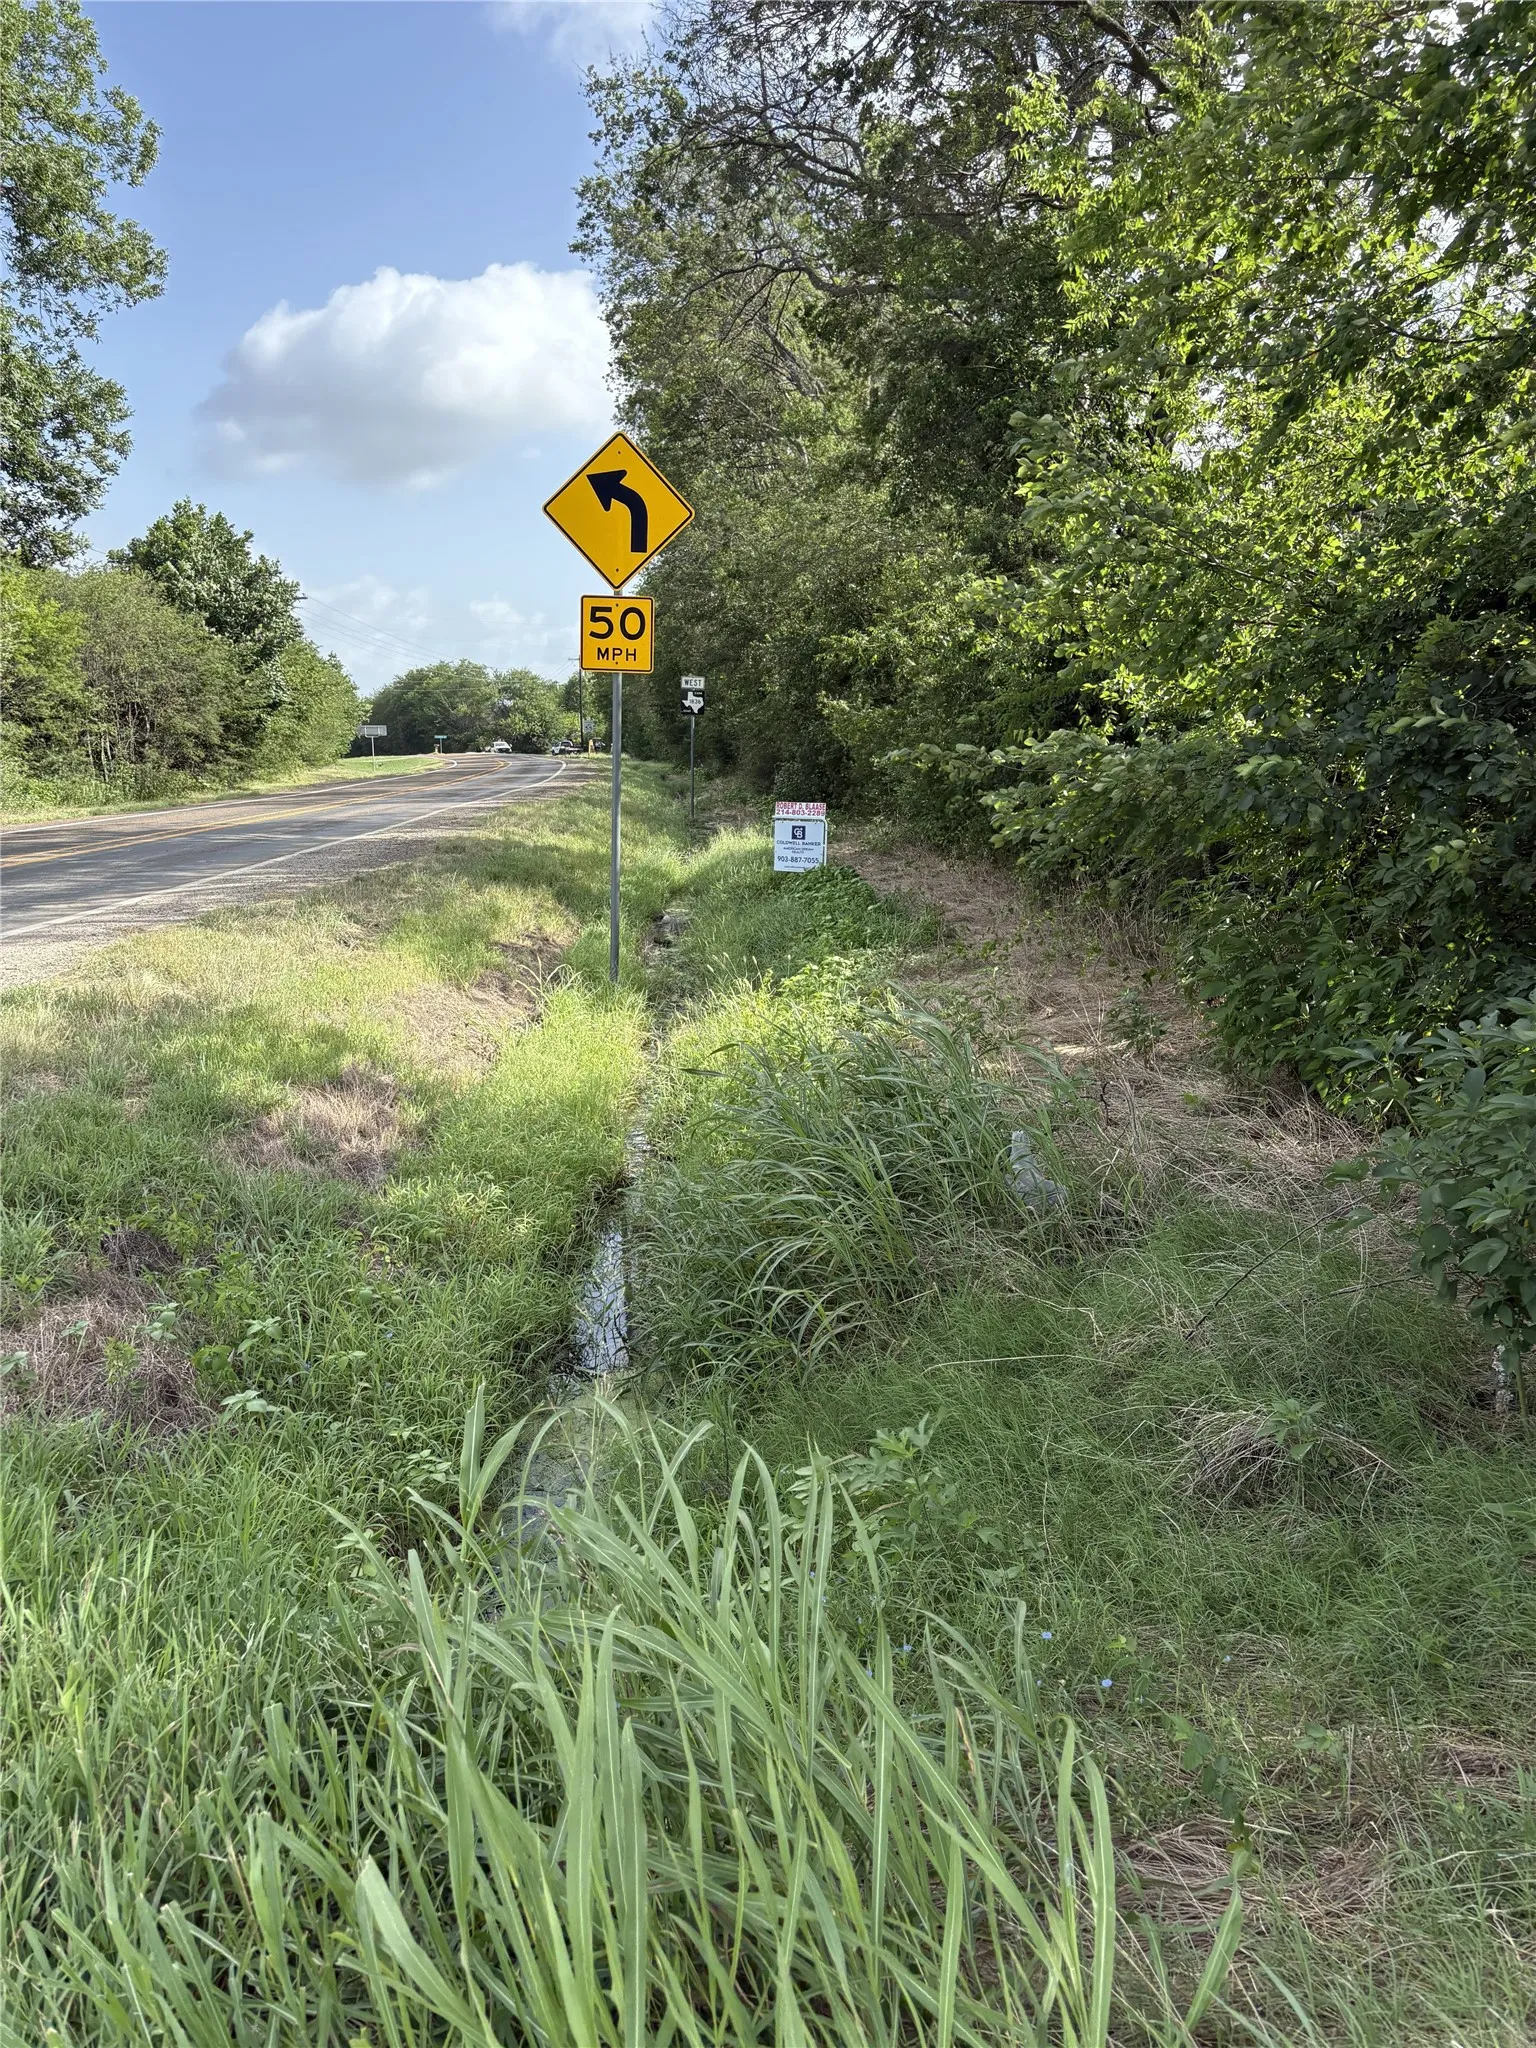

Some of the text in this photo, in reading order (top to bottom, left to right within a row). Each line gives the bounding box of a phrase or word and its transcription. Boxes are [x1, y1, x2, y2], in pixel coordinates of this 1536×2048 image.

[589, 606, 646, 641] 50
[597, 647, 637, 662] MPH
[777, 855, 819, 864] 903-887-7055
